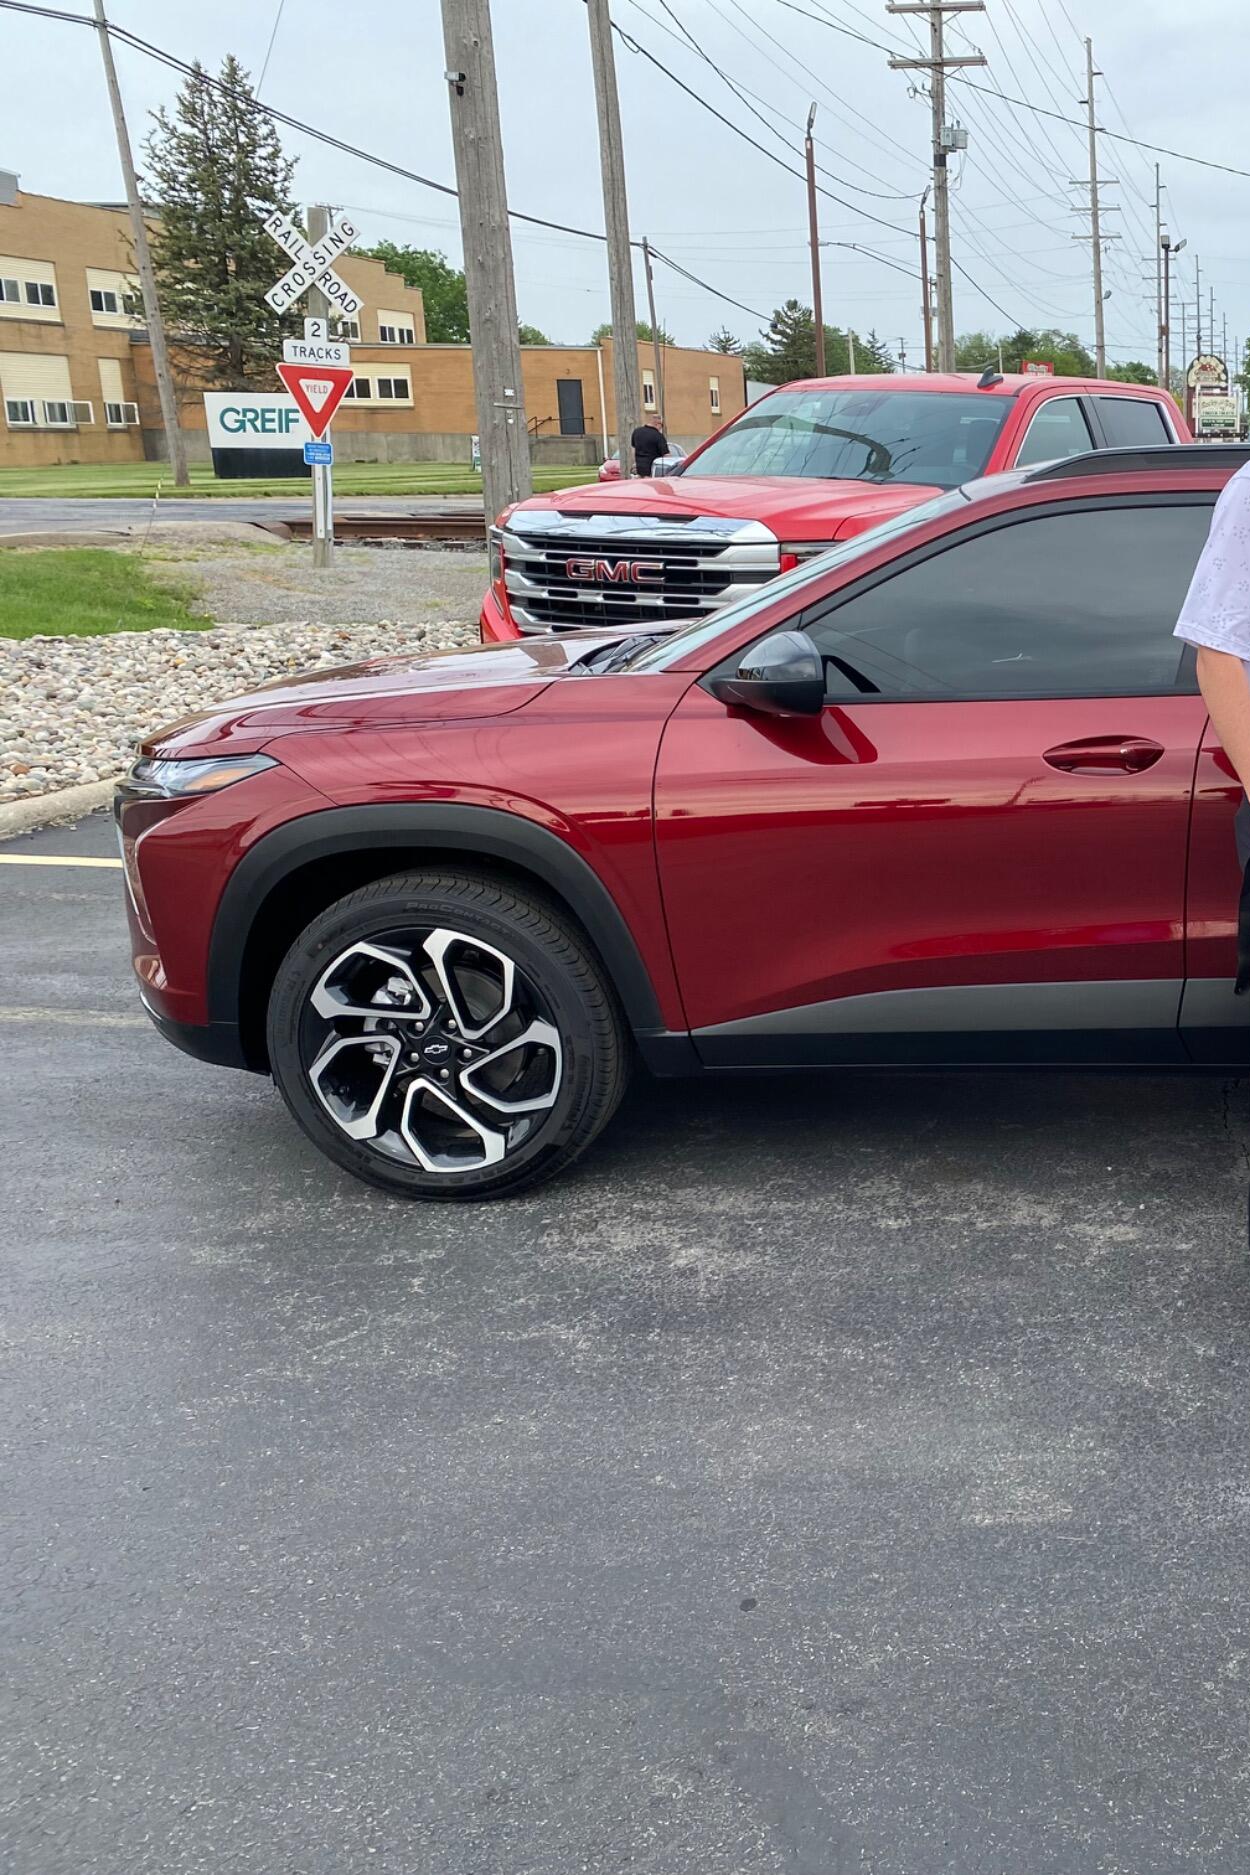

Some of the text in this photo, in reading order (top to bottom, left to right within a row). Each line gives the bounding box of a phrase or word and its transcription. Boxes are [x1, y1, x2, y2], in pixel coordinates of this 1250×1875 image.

[268, 217, 358, 314] RAIL ROAD
[270, 221, 355, 308] CROSSING
[310, 320, 322, 338] 2
[291, 345, 342, 361] TRACKS
[304, 383, 329, 395] YIELD
[218, 406, 301, 434] GREIF
[564, 558, 665, 584] GMC
